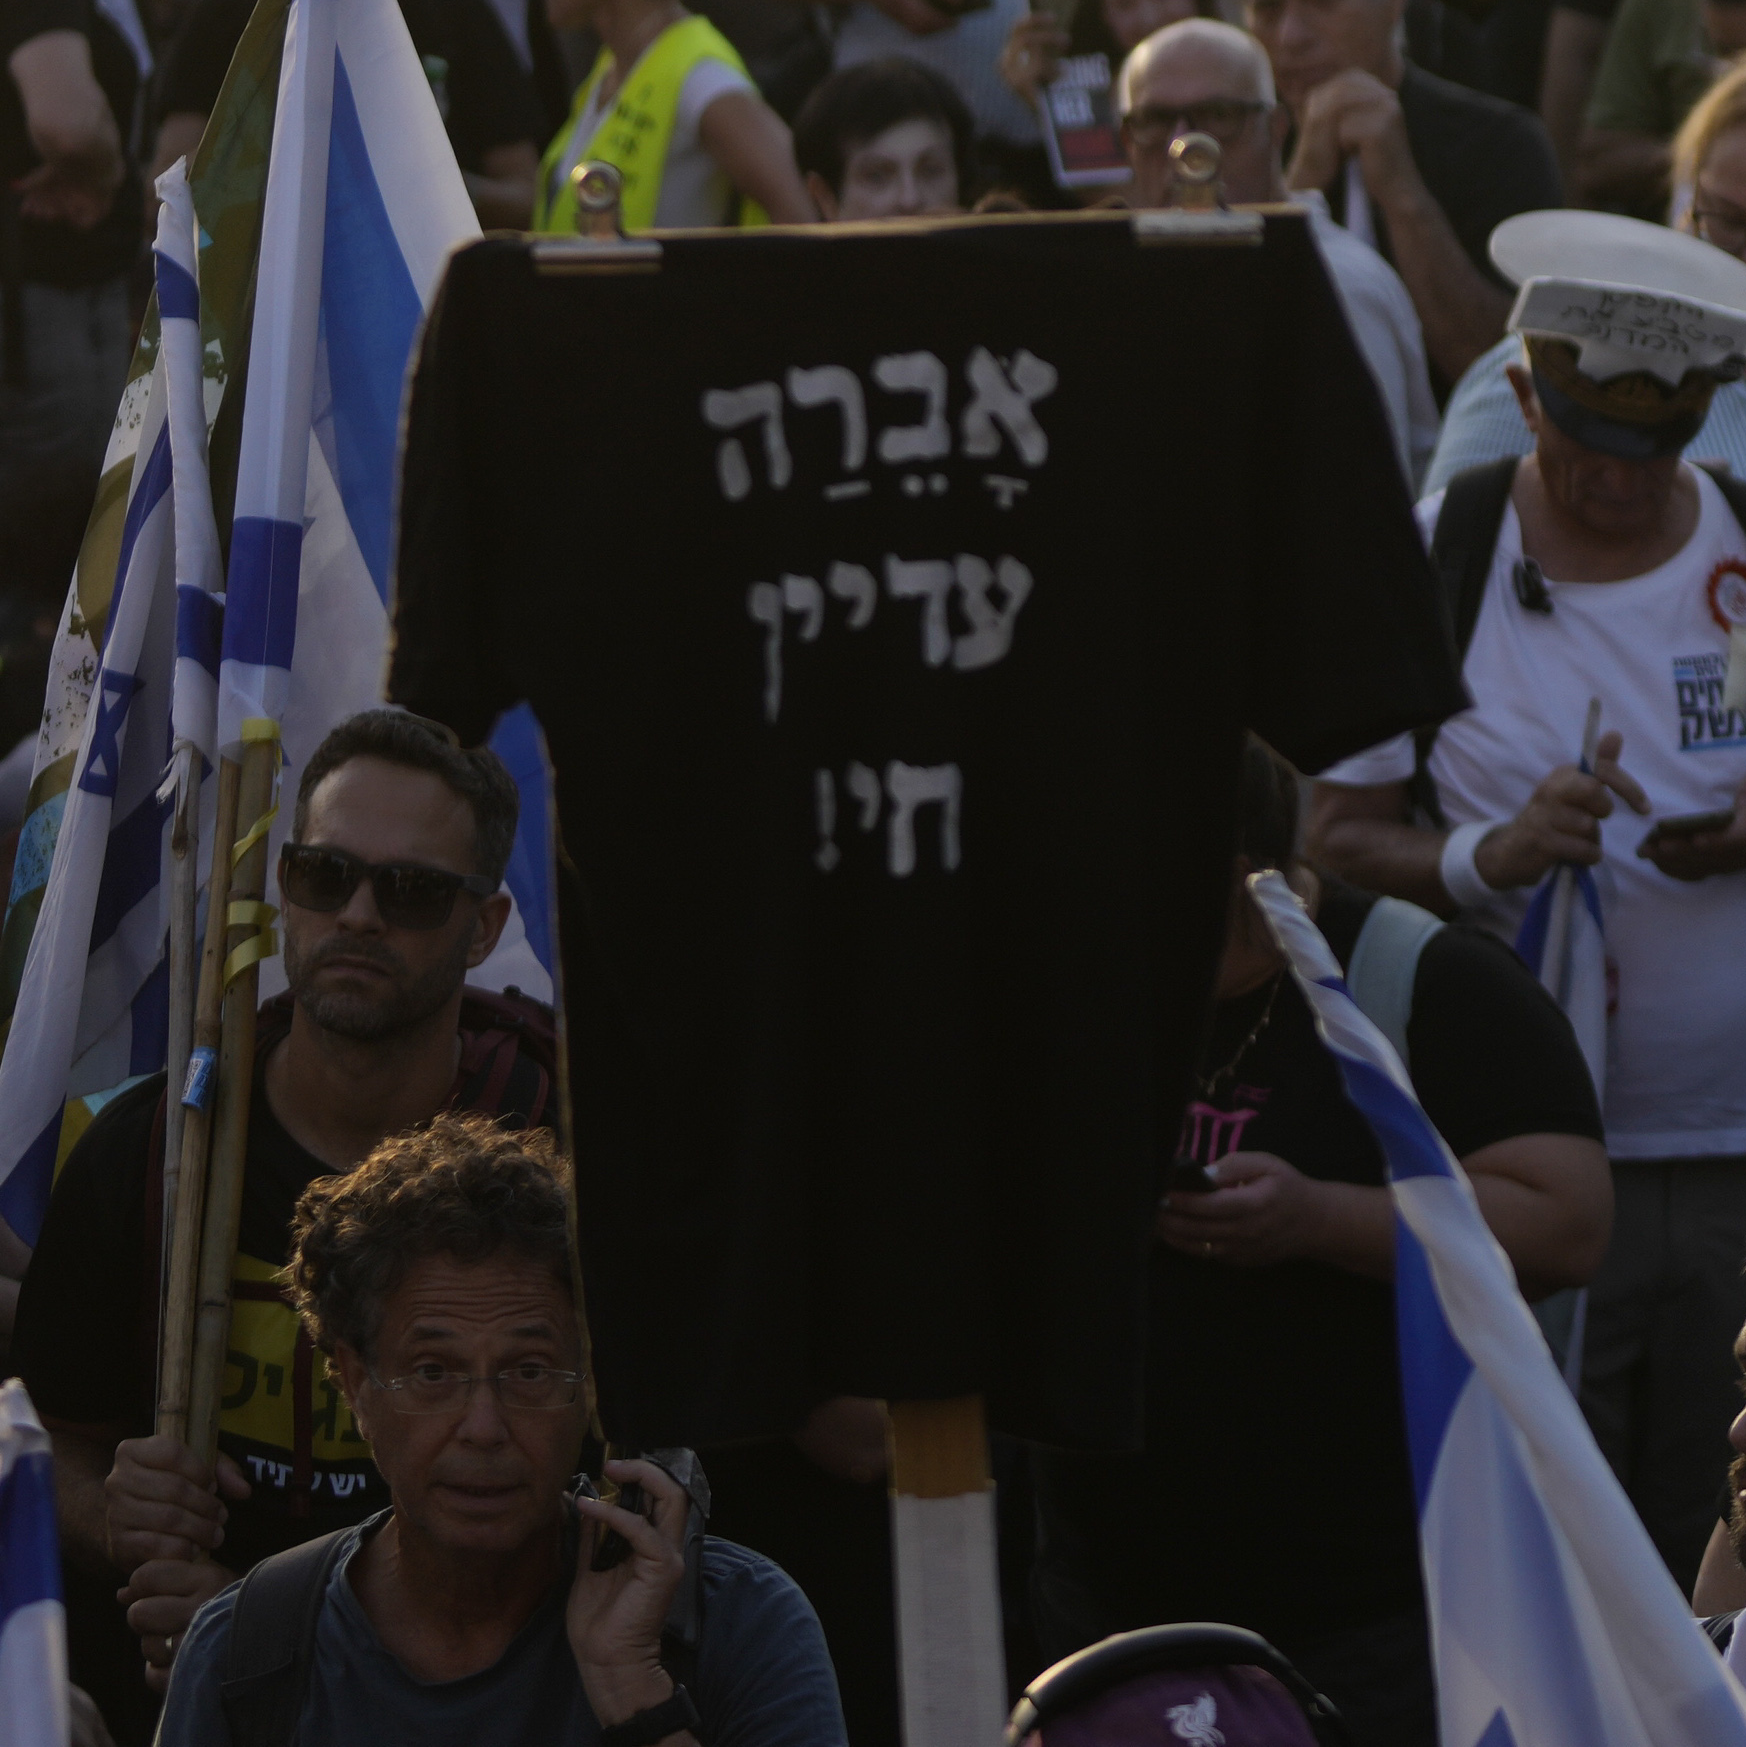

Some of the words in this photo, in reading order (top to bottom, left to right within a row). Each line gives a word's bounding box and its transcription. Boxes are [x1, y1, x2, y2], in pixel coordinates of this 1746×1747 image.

[748, 553, 1036, 725] עדיין
[812, 760, 963, 879] חי!
[328, 1470, 367, 1498] יש
